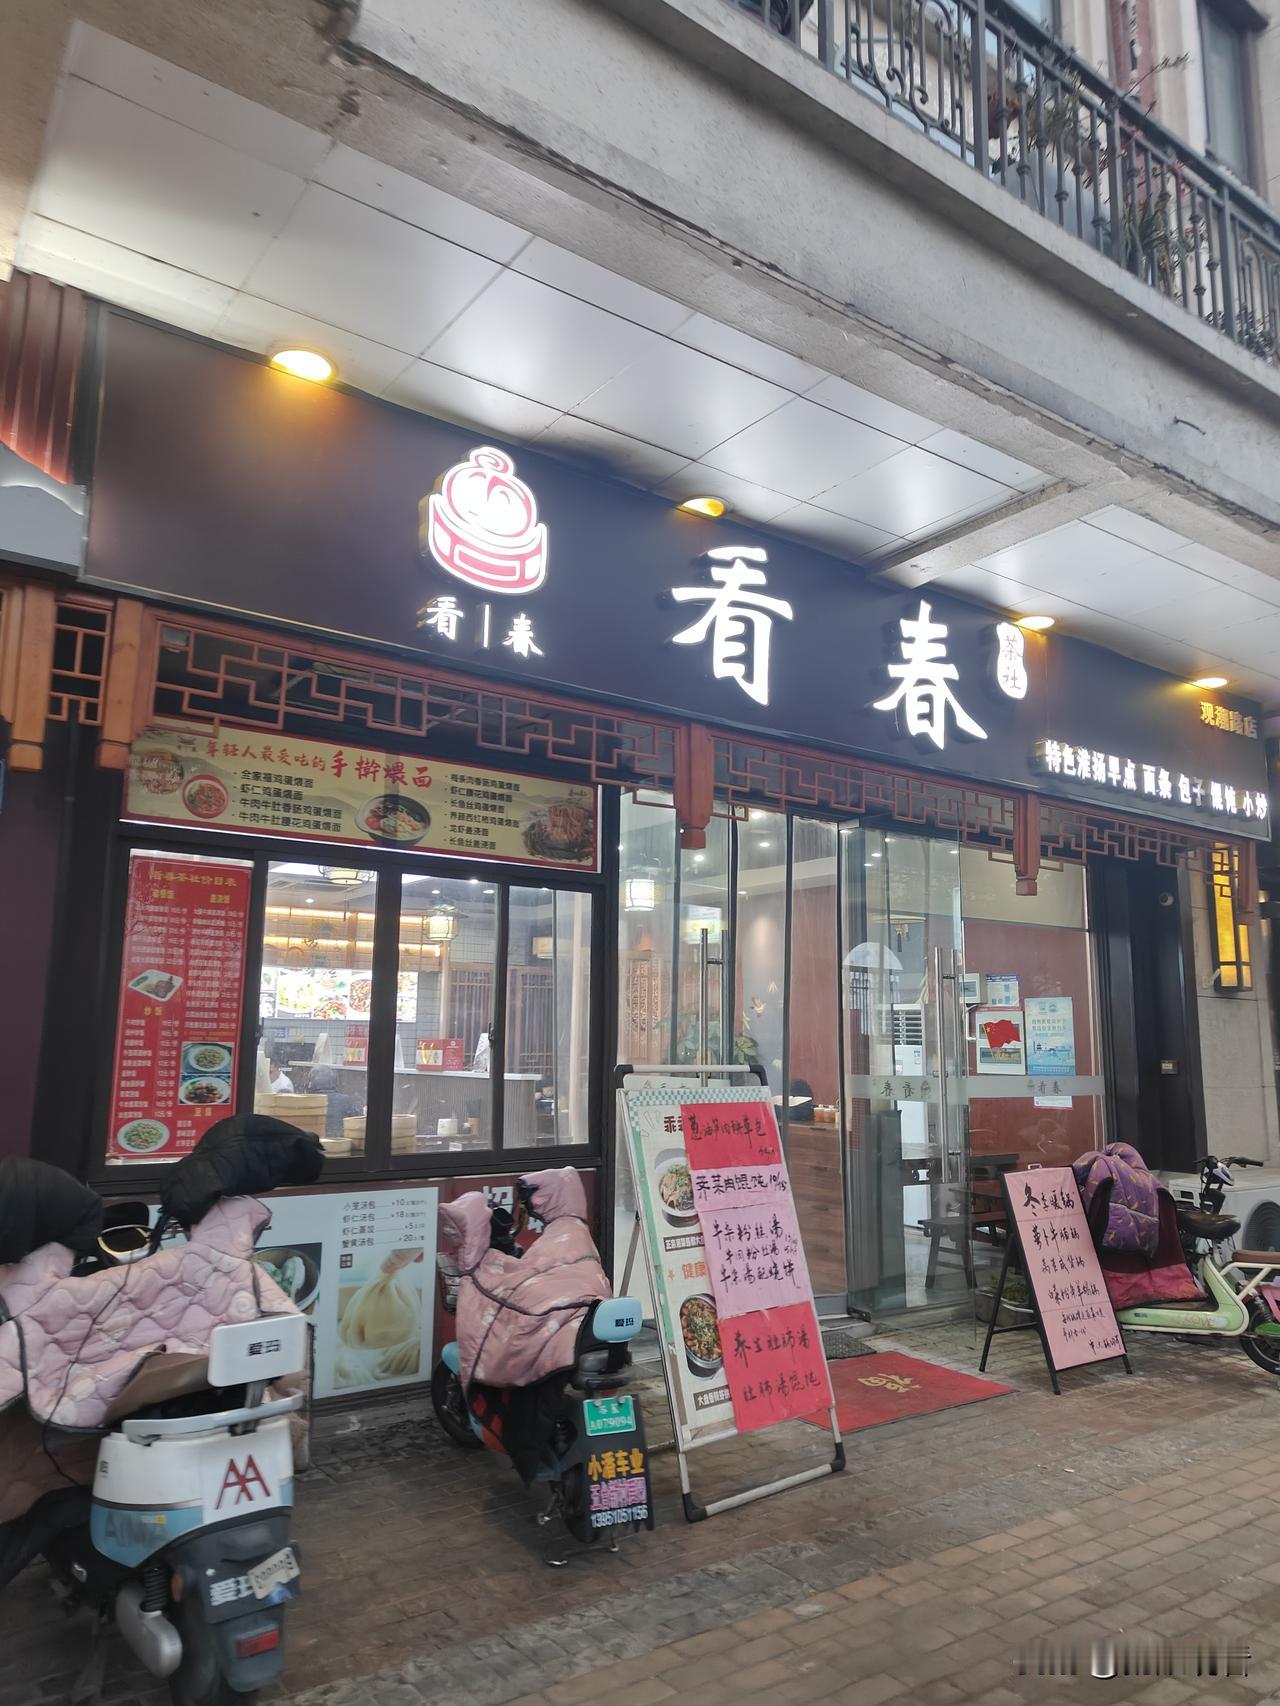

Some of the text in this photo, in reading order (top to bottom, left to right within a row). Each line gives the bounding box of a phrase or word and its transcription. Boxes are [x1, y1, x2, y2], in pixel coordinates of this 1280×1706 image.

[671, 546, 988, 750] 看春
[1045, 739, 1137, 790] 特色淮扬早点
[1142, 763, 1172, 799] 面条
[1178, 773, 1205, 807] 包子
[1242, 790, 1268, 820] 小炒
